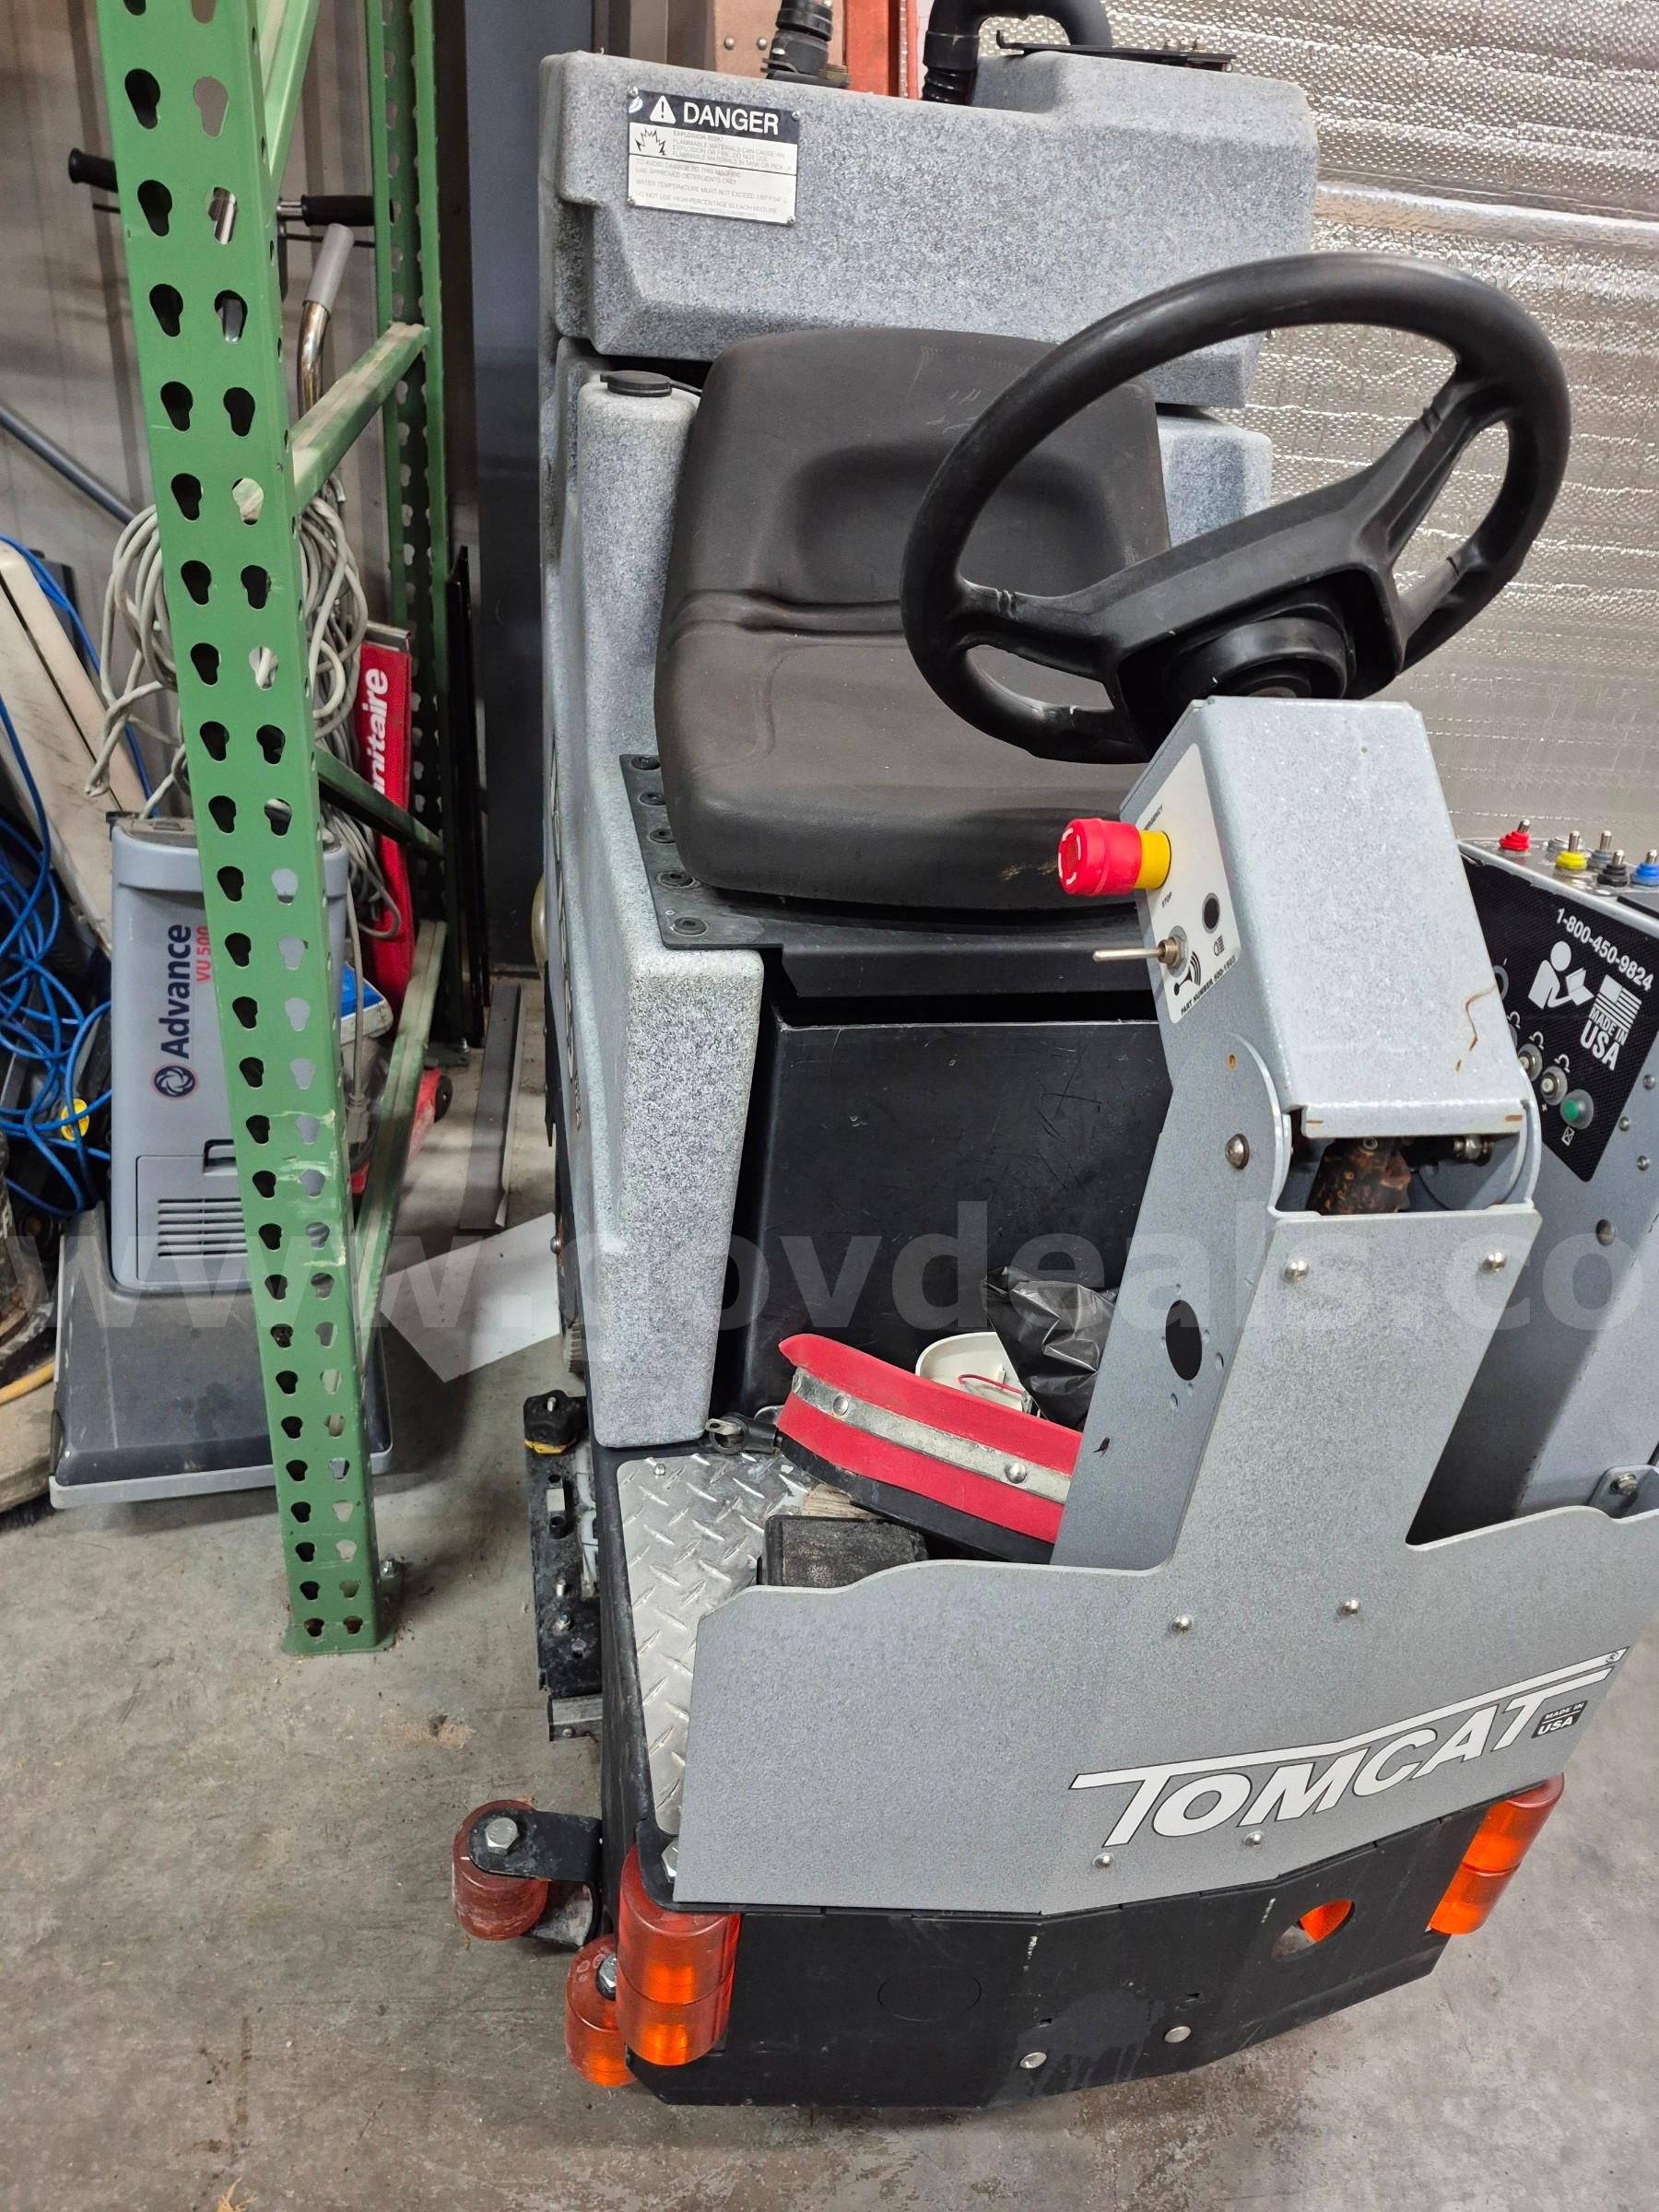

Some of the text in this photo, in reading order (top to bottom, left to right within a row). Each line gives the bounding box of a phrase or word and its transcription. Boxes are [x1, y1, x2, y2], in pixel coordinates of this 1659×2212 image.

[683, 101, 779, 135] DANGER
[195, 925, 211, 982] VU 500
[1556, 908, 1654, 992] 1-800-450-9824
[159, 924, 192, 1059] Advance
[1580, 1019, 1620, 1071] USA
[1588, 1006, 1629, 1046] MADE IN
[1536, 1715, 1574, 1735] USA
[1544, 1701, 1585, 1720] MADE IN
[1069, 1646, 1630, 1848] TOMCAT
